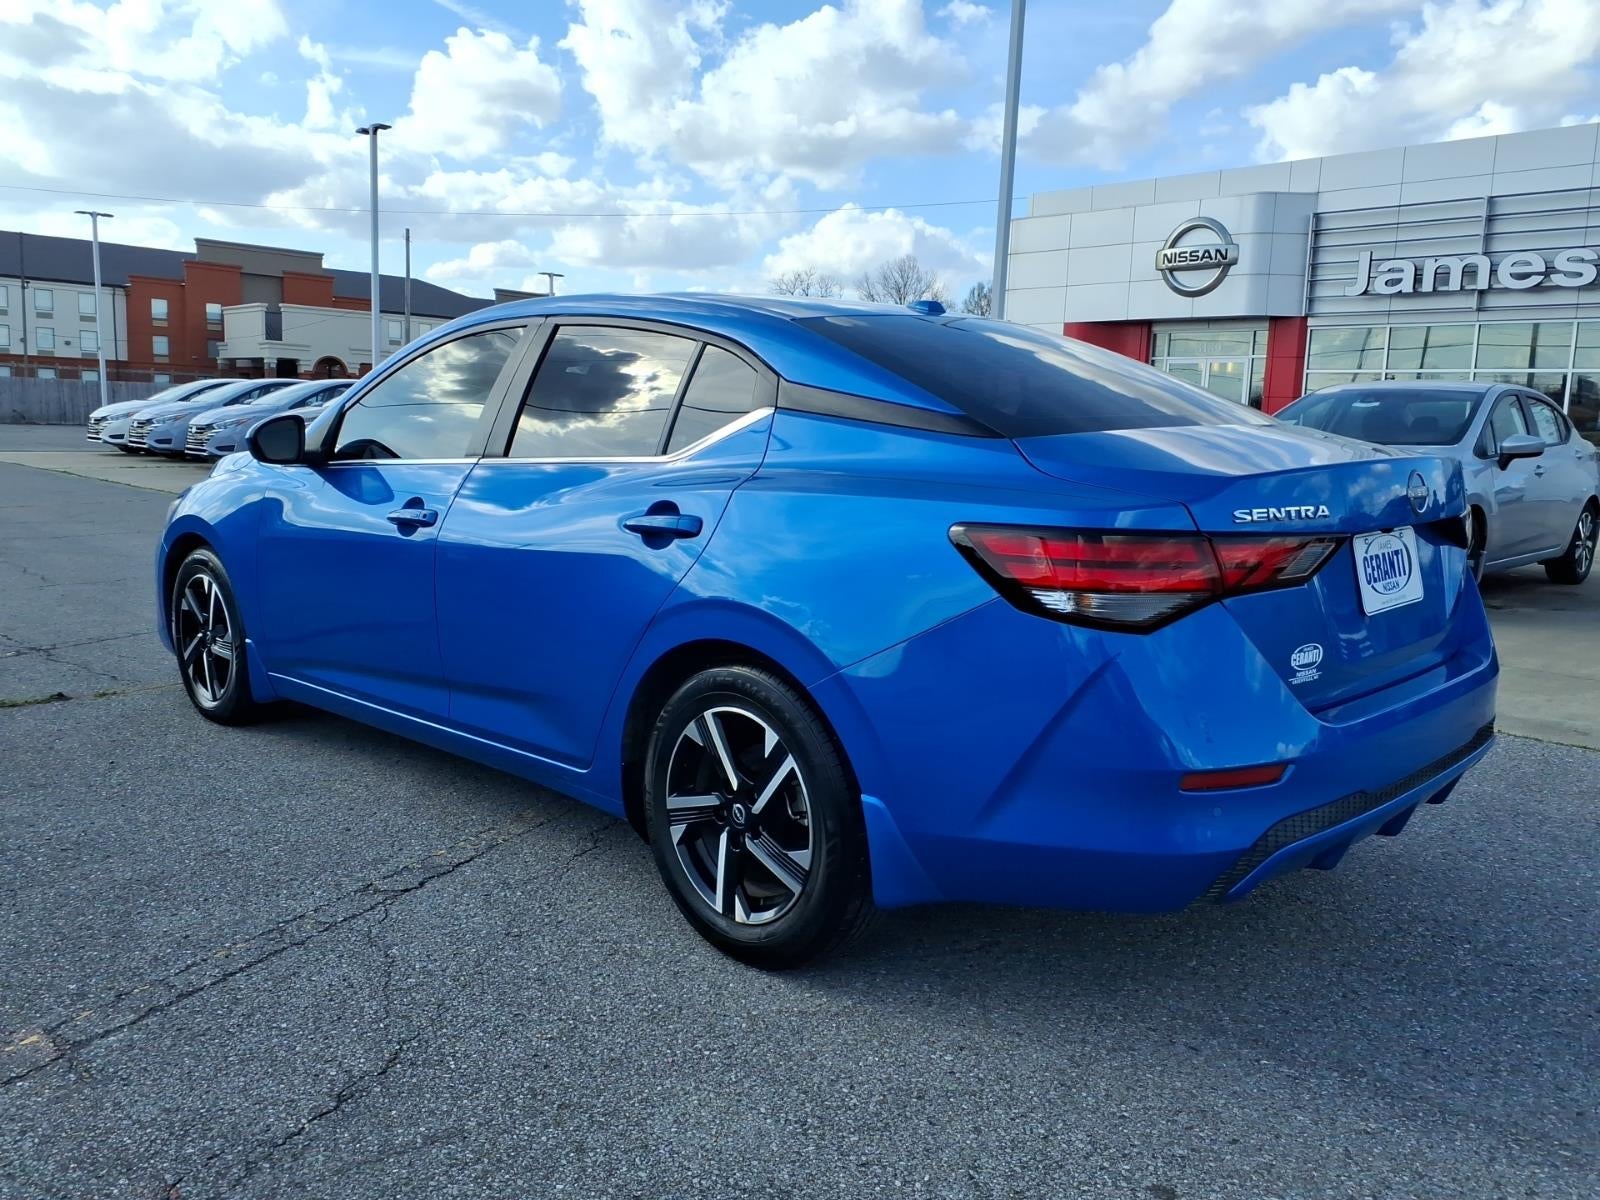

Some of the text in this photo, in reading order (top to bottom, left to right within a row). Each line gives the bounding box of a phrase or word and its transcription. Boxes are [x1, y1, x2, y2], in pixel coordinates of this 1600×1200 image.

[1162, 248, 1229, 265] NISSAN
[1349, 247, 1599, 297] James
[1233, 505, 1330, 523] SENTRA
[1362, 548, 1407, 586] CERANTI
[1382, 580, 1400, 592] NISSAN
[1290, 649, 1319, 667] CERANTI
